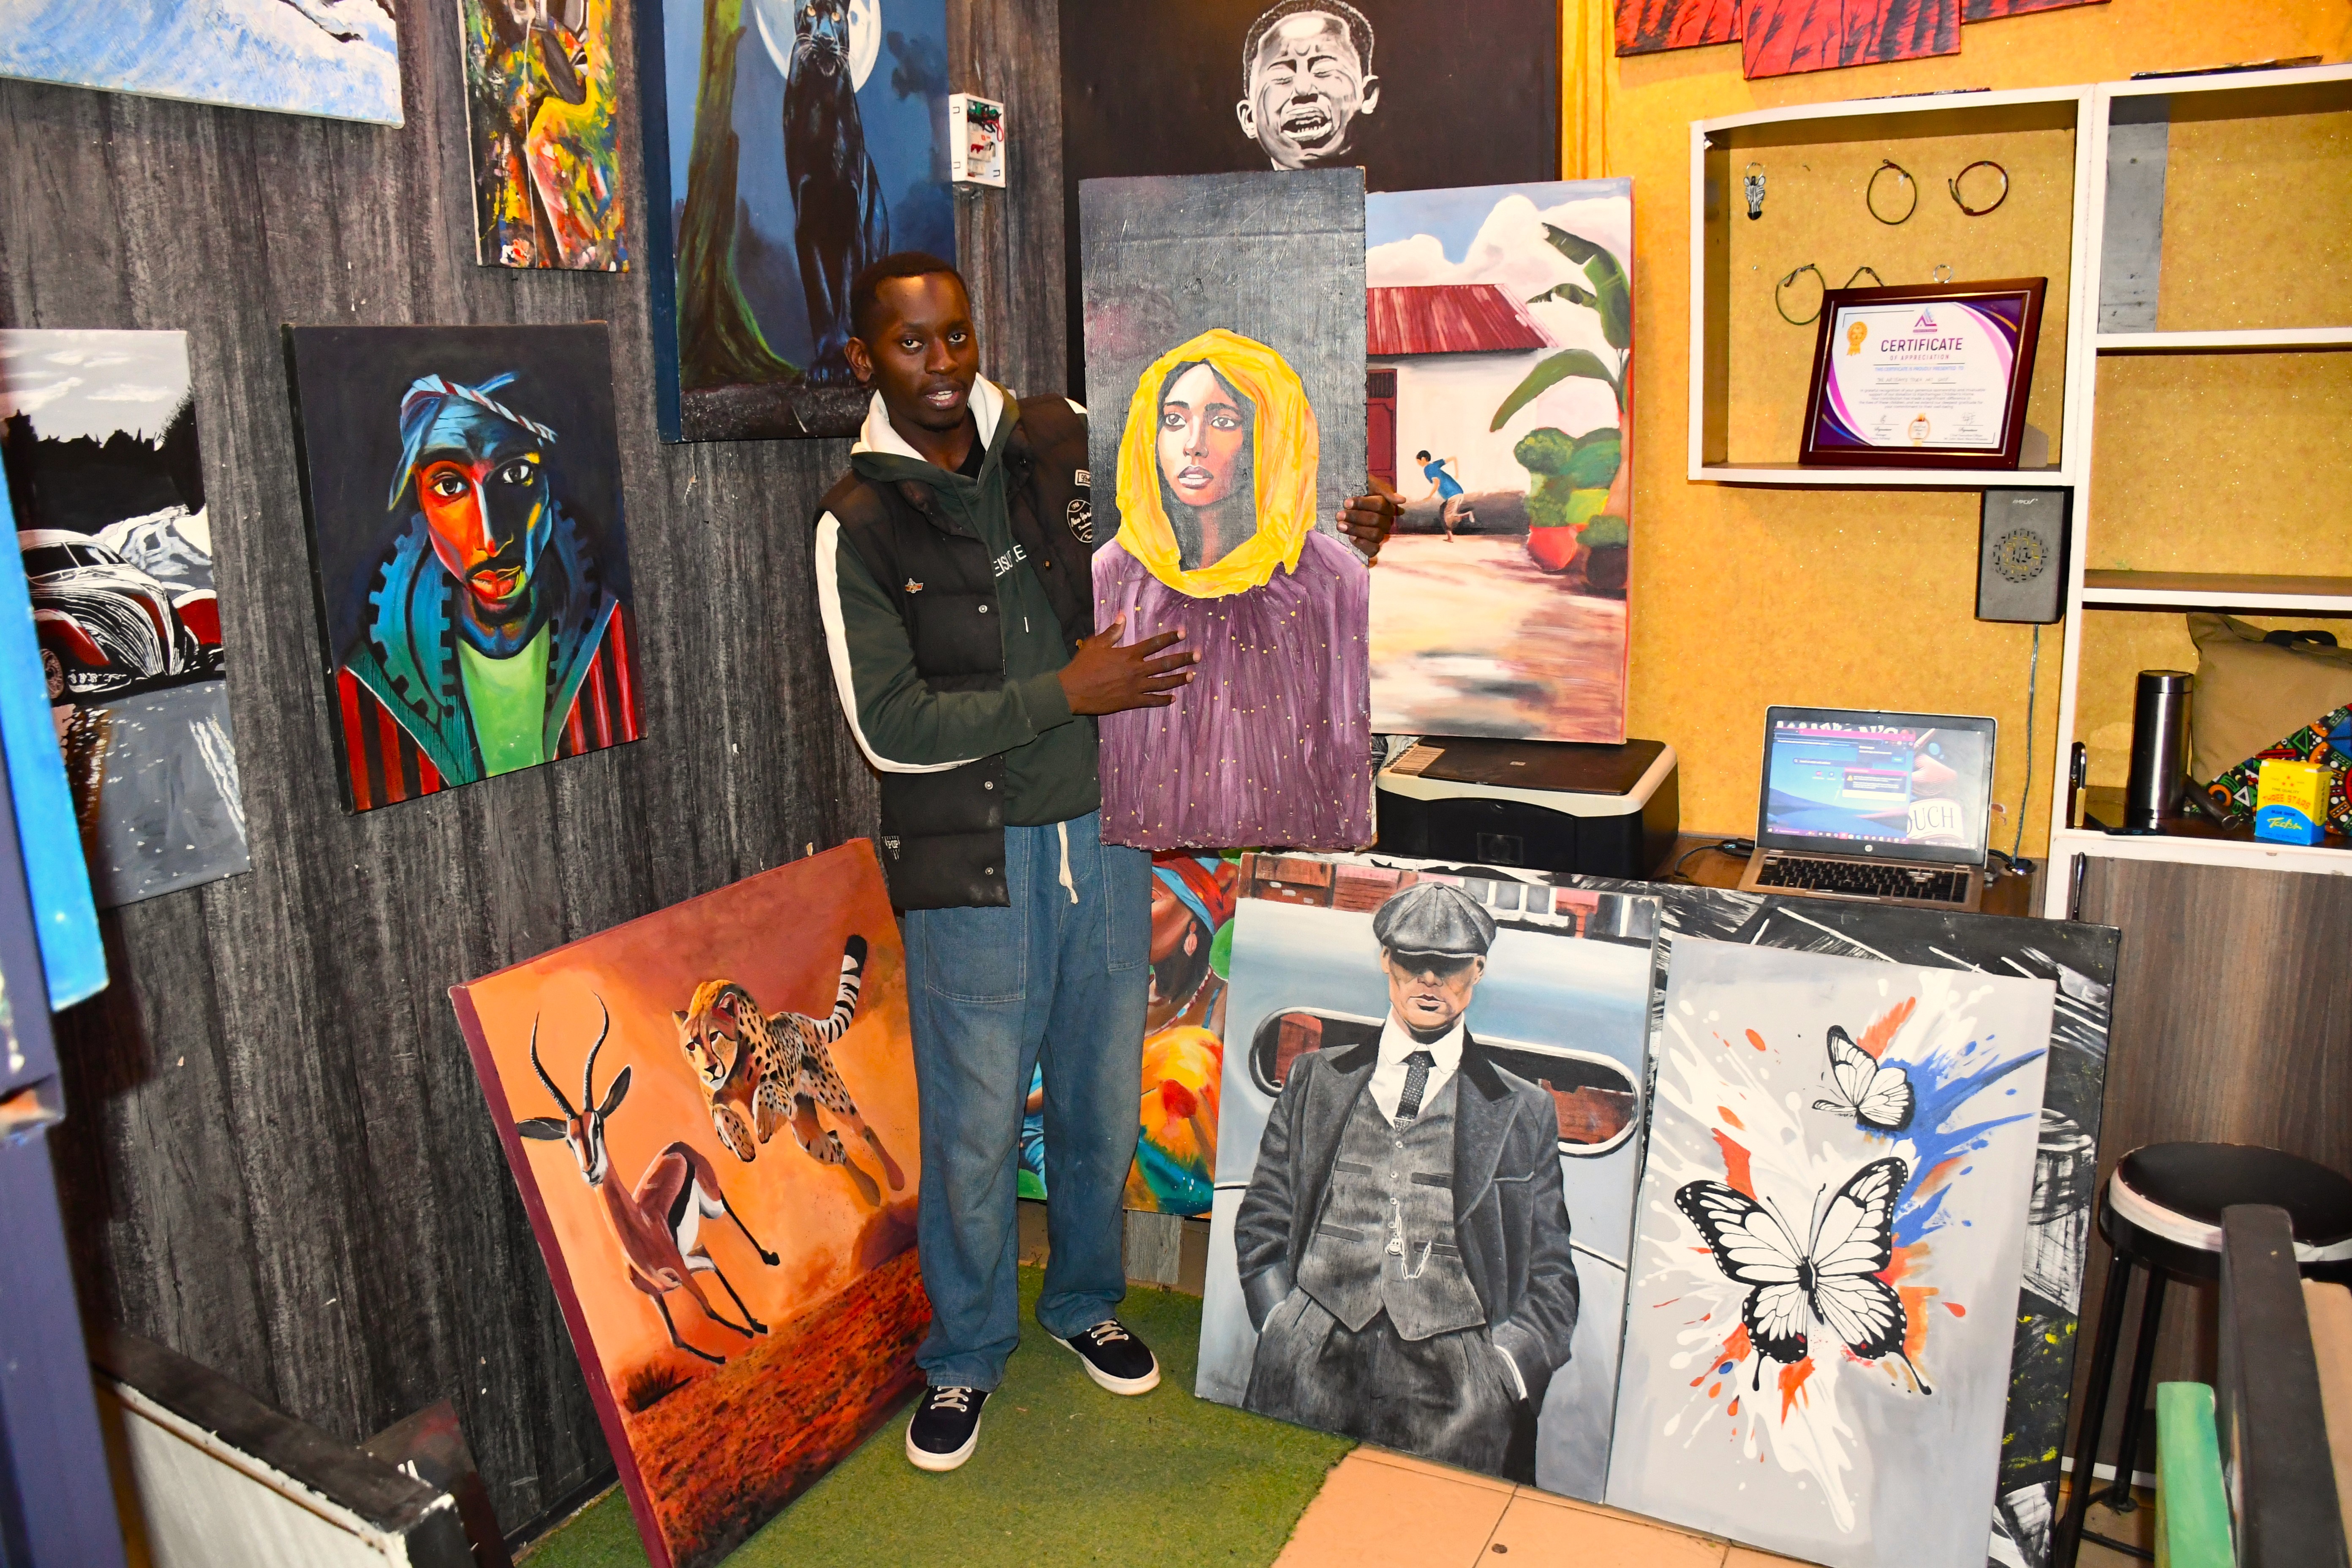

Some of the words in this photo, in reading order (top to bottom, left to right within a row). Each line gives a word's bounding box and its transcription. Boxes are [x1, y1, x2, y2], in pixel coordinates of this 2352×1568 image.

[1881, 338, 1963, 352] CERTIFICATE
[2262, 794, 2284, 804] THREE
[2288, 795, 2311, 809] STARS
